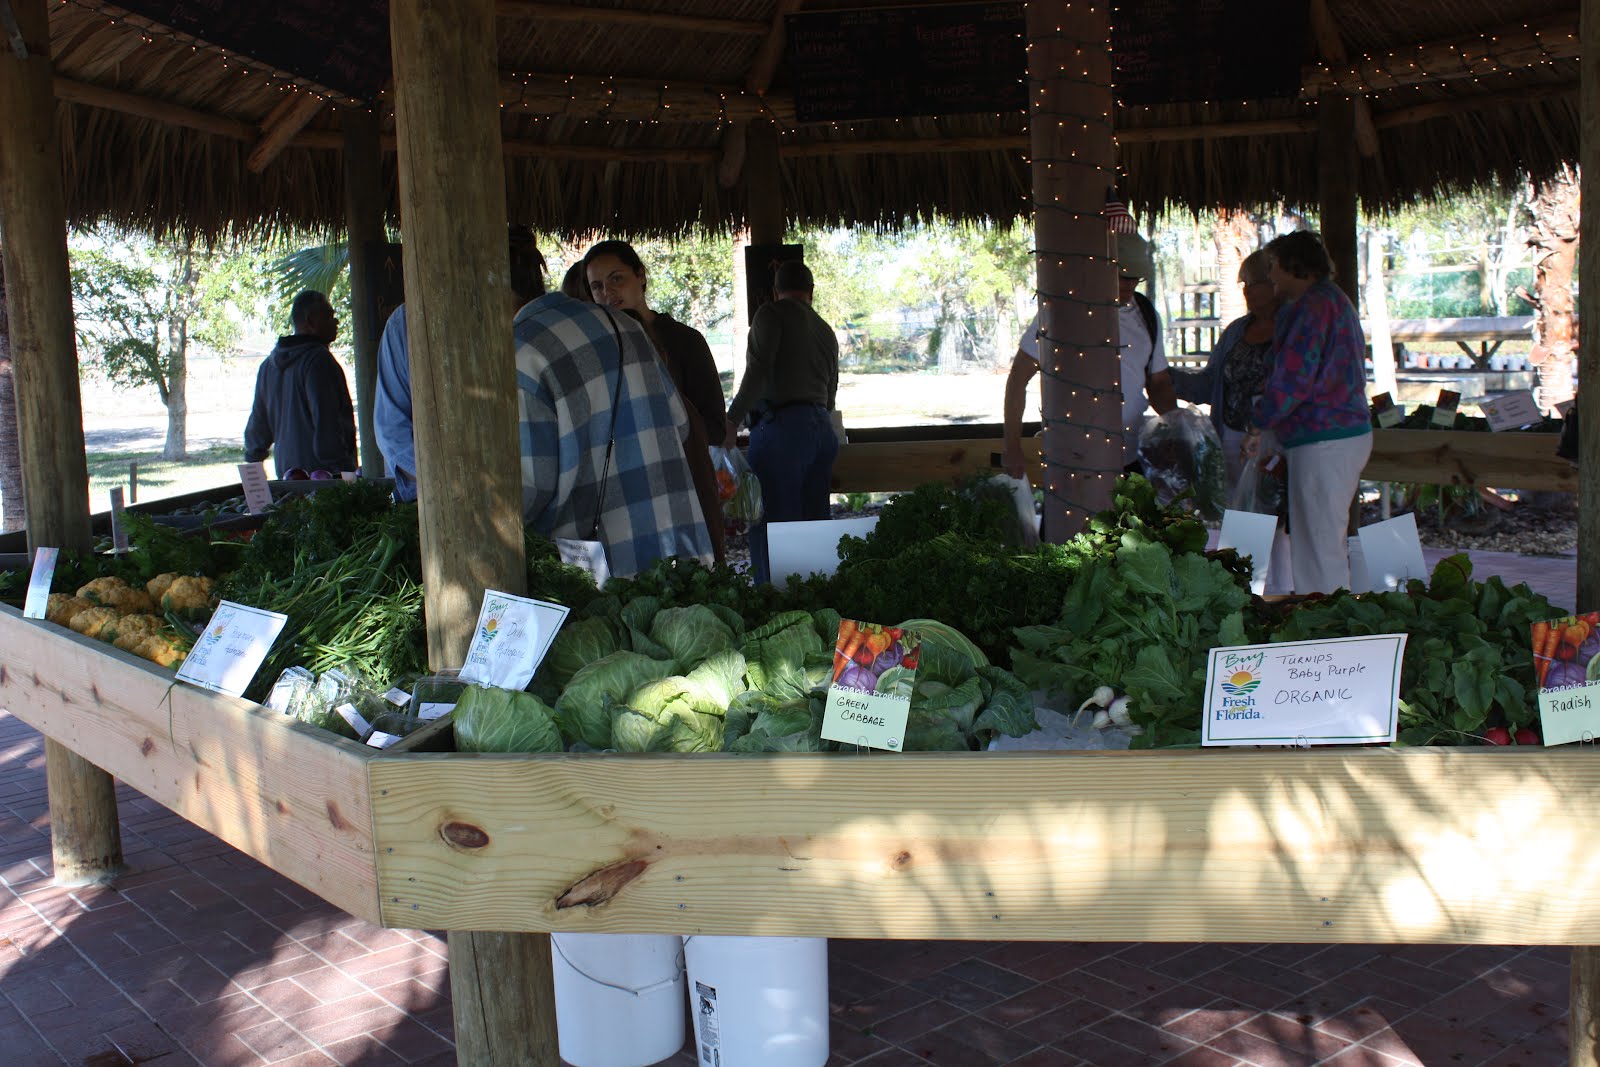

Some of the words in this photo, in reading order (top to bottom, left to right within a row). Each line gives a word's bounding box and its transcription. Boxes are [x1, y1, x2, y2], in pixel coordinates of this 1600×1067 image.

[1220, 651, 1267, 669] Buy
[1275, 653, 1334, 665] TURNIPS
[1328, 662, 1367, 676] Purple
[831, 683, 870, 694] Organic
[872, 690, 909, 701] Produce
[1540, 681, 1583, 694] Organic
[837, 697, 868, 710] GREEN
[1222, 695, 1256, 707] Fresh
[1274, 688, 1353, 705] ORGANIC
[1549, 695, 1591, 712] Radish
[841, 710, 885, 726] CABBAGE
[1215, 708, 1261, 721] Florida
